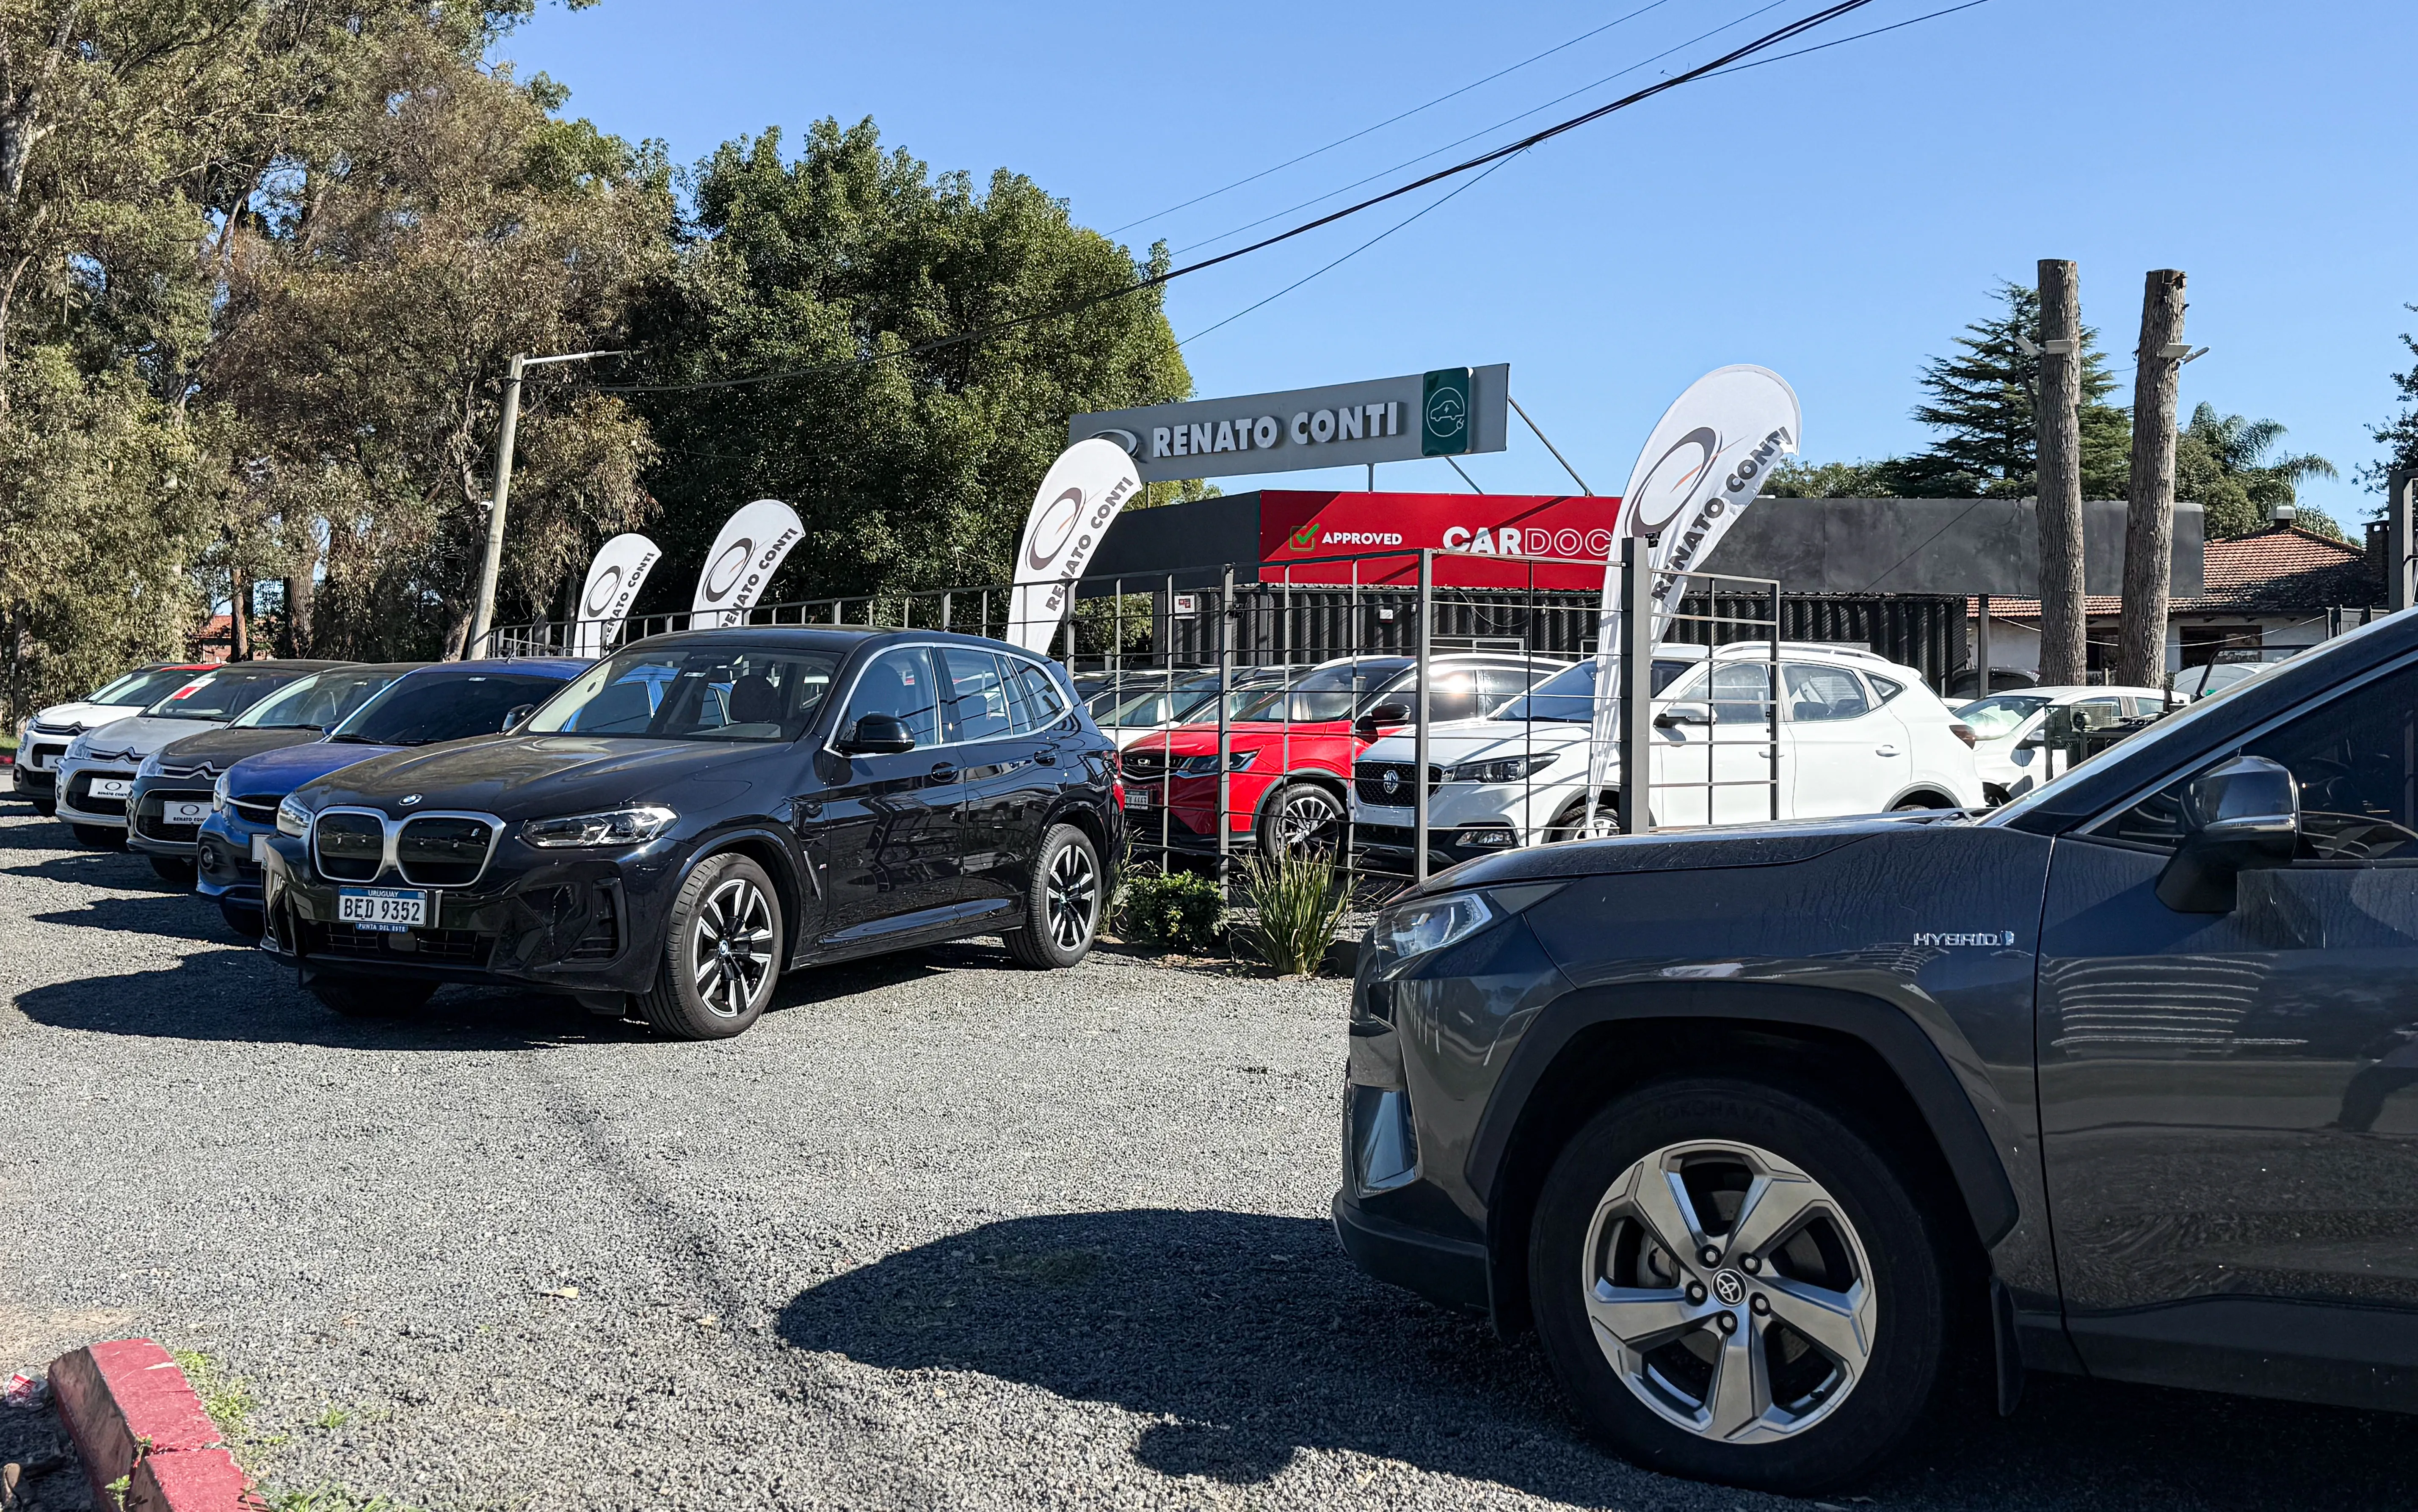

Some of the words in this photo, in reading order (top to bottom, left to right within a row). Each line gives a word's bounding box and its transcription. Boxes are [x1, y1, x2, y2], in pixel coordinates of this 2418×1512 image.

[1153, 415, 1278, 458] RENATO
[1291, 401, 1398, 445] CONTI
[1726, 426, 1792, 493] CONTI
[1090, 477, 1134, 529] CONTI
[759, 528, 798, 570] CONTI
[1322, 531, 1402, 546] APPROVED
[606, 592, 629, 637] ENATO
[627, 552, 655, 588] CONTI
[344, 898, 374, 919] BED
[381, 900, 420, 922] 9352
[367, 889, 399, 898] URUGUAY
[1913, 933, 1998, 946] HYBRID
